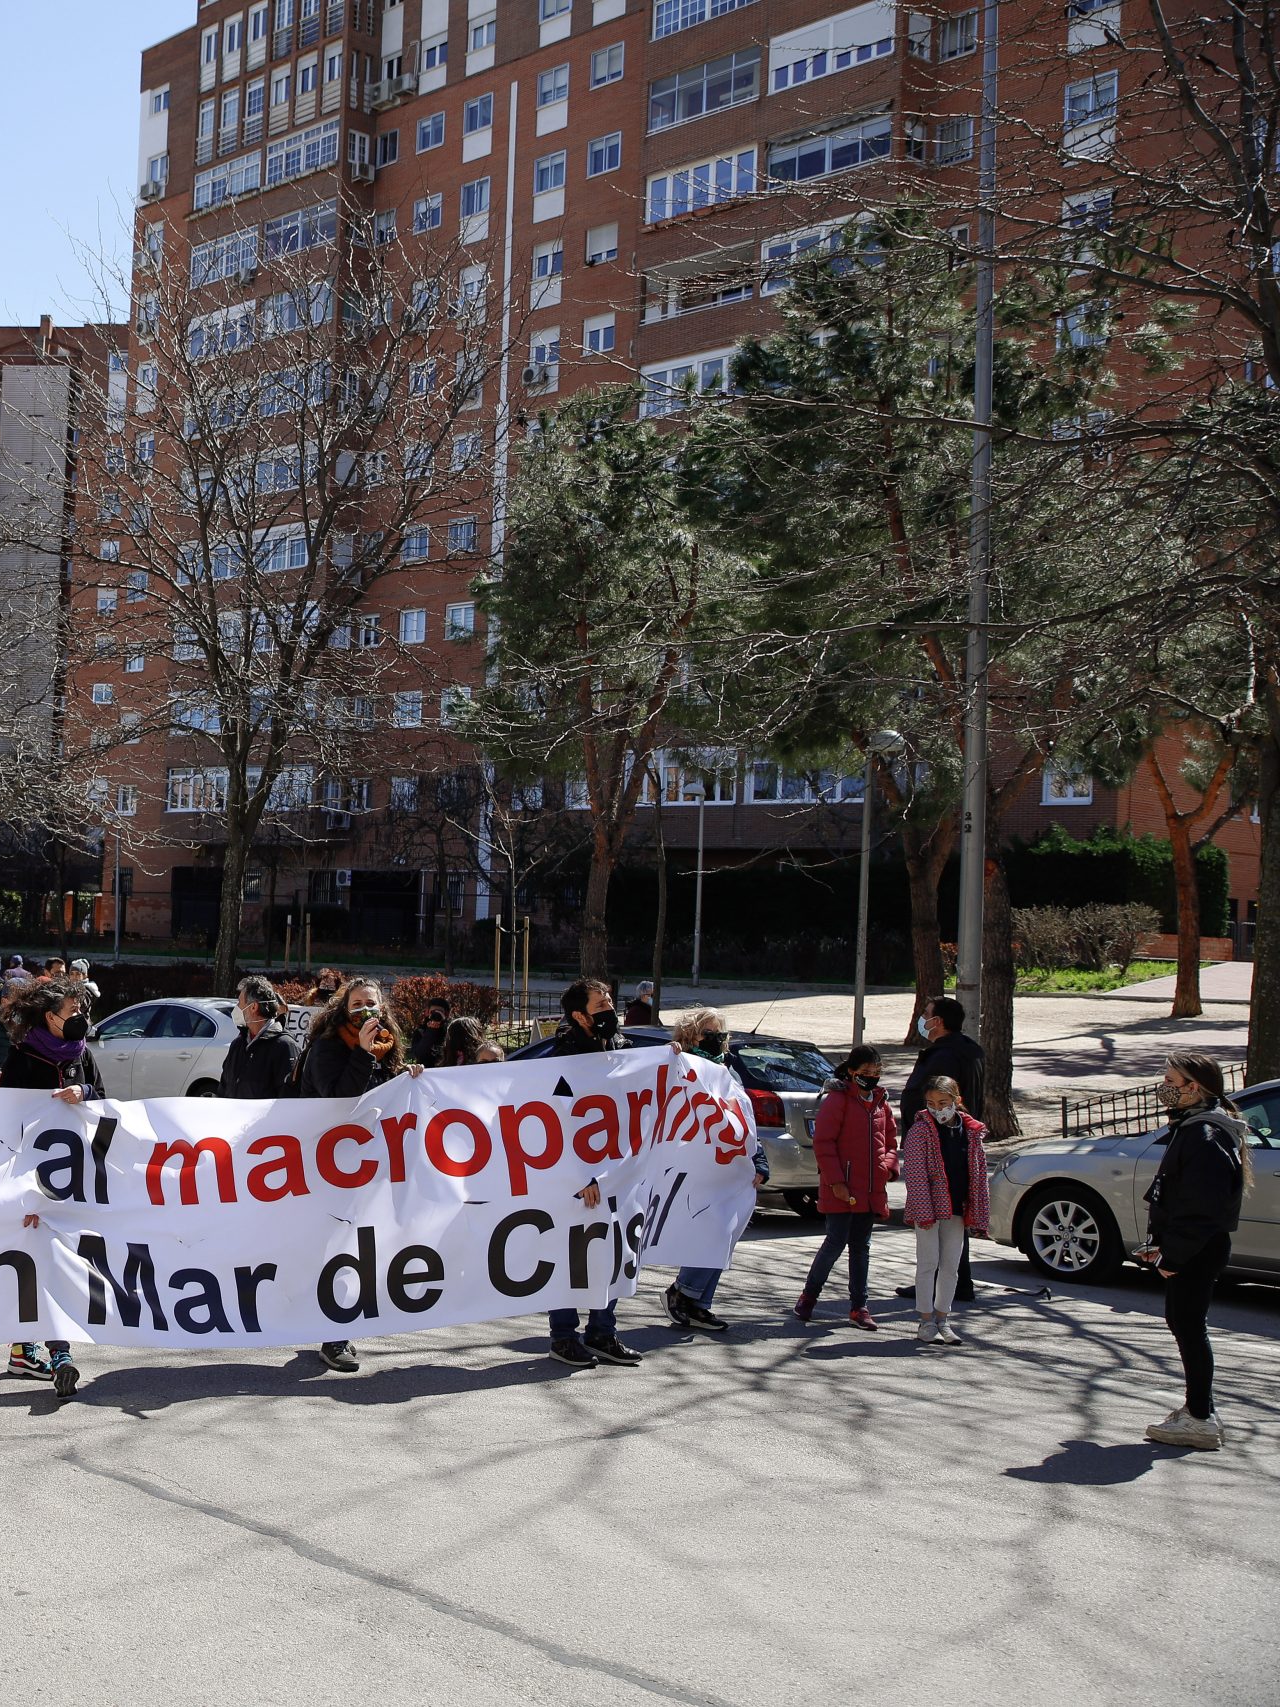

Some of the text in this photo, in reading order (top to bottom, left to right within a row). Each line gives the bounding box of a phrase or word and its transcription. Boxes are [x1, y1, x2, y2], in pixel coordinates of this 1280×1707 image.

[33, 1117, 118, 1205] al
[145, 1064, 749, 1206] macroparking
[77, 1235, 278, 1334] Mar
[317, 1226, 445, 1324] de
